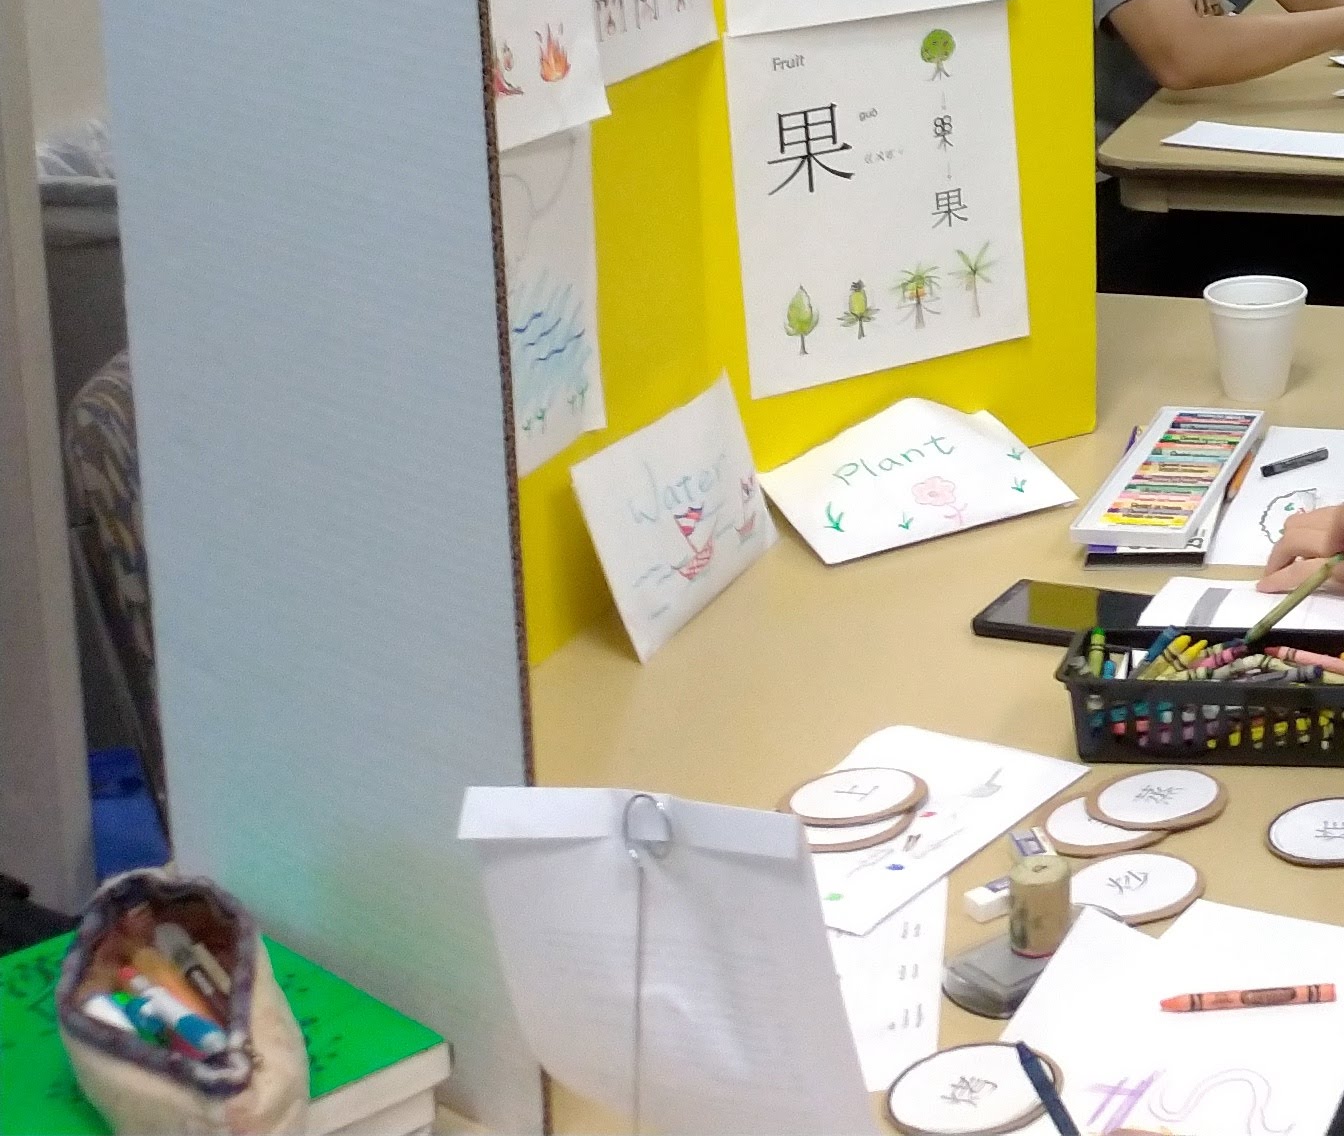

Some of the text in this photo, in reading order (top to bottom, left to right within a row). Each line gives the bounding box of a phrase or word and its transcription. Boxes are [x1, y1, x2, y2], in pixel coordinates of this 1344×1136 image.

[772, 54, 805, 71] Fruit
[767, 102, 855, 196] 果
[931, 187, 968, 229] 果
[832, 435, 955, 486] Plant
[628, 453, 725, 524] Water
